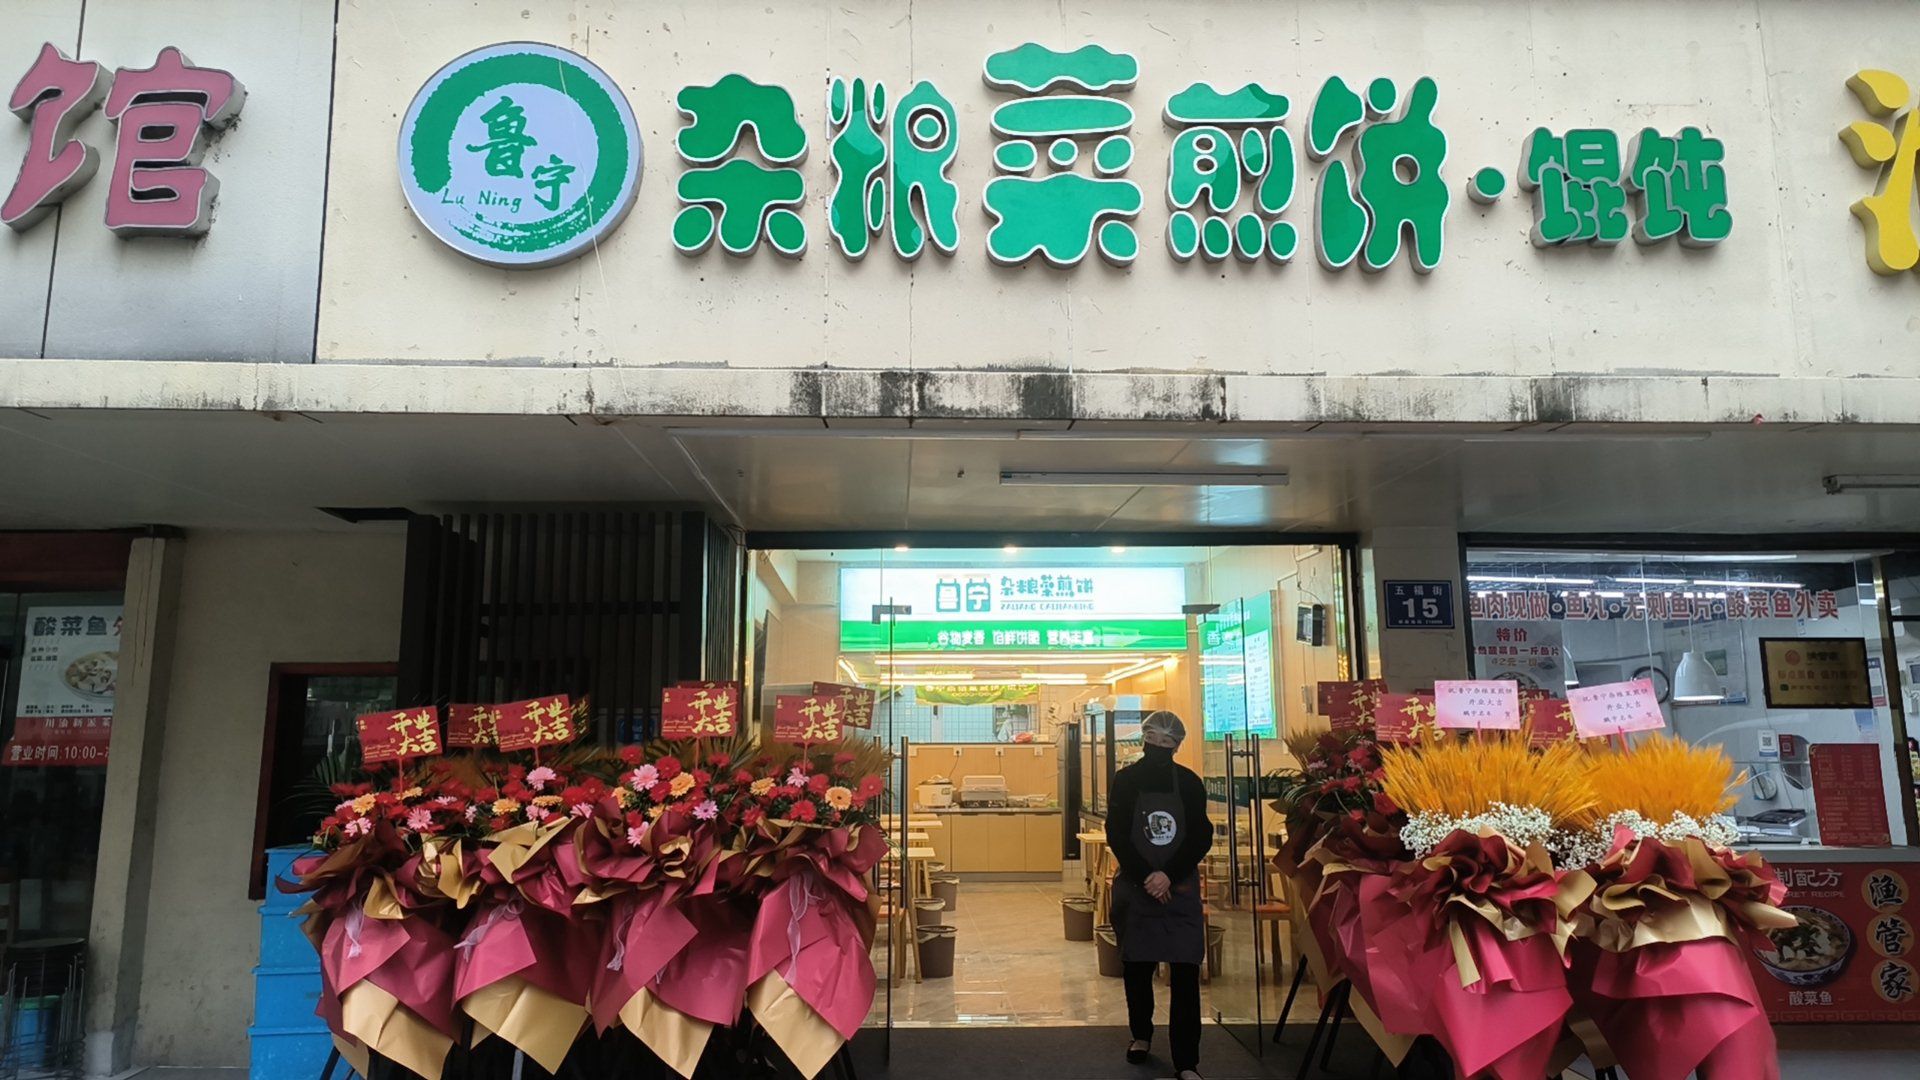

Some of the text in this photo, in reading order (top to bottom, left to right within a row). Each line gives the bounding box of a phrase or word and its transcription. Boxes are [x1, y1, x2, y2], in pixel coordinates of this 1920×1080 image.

[0, 42, 240, 232] 馆
[441, 188, 522, 213] Lu Ning
[1000, 574, 1093, 597] 杂粮菜煎饼
[1402, 598, 1439, 618] 15
[1496, 627, 1528, 642] 特价
[522, 698, 571, 725] 开业
[688, 690, 736, 715] 开业
[798, 699, 842, 721] 开业
[387, 710, 439, 737] 开业
[530, 715, 571, 744] 大吉
[693, 709, 734, 735] 大吉
[802, 717, 841, 741] 大吉
[397, 728, 440, 756] 大吉
[1788, 991, 1834, 1006] 酸菜鱼
